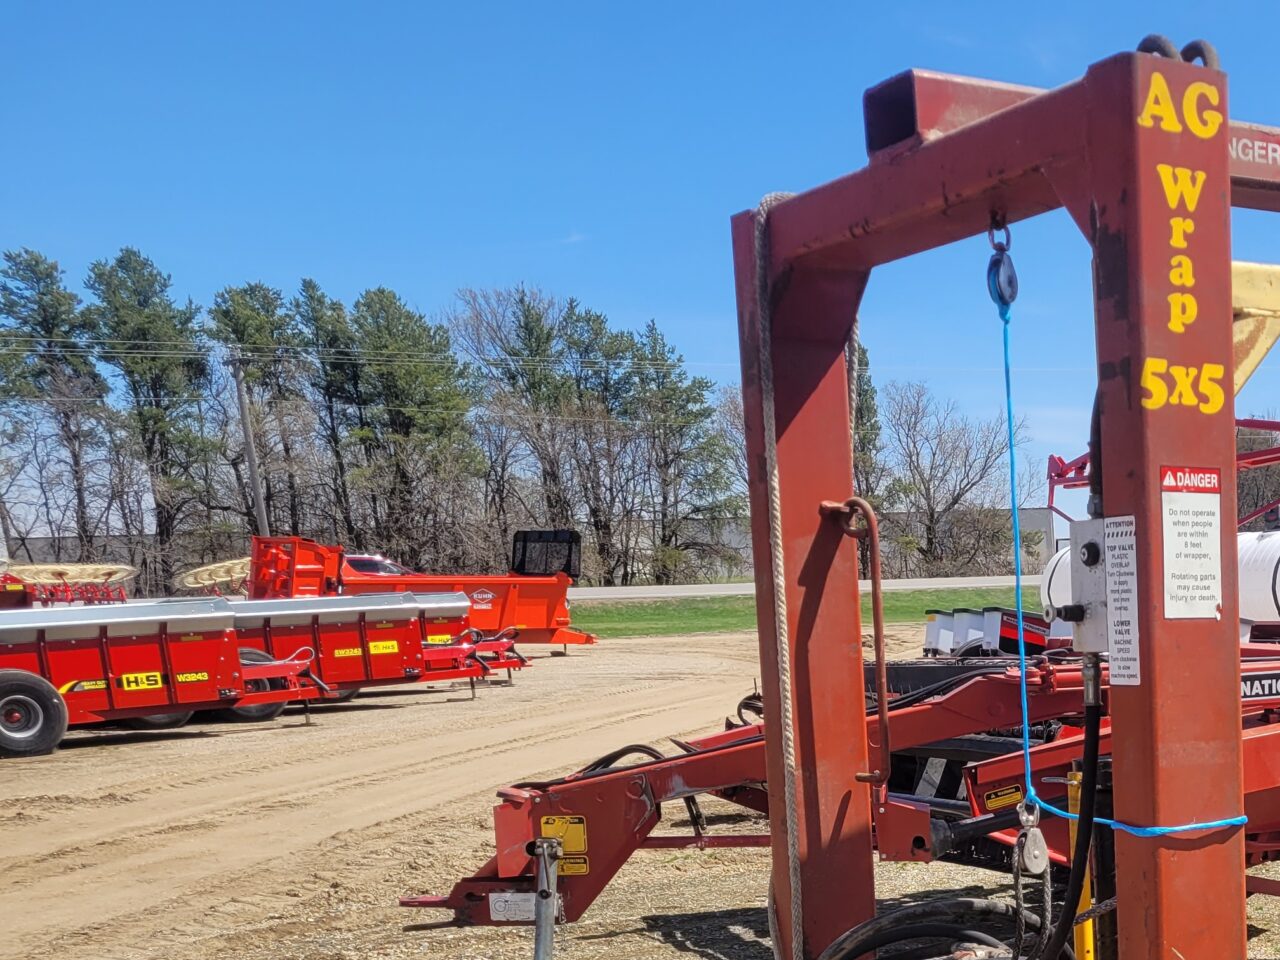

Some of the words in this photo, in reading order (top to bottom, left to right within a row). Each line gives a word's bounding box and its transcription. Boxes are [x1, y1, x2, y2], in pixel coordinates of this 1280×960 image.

[1137, 72, 1223, 139] AG
[1176, 471, 1218, 488] DANGER
[1168, 508, 1178, 516] Do
[1180, 509, 1190, 517] not
[1191, 510, 1216, 518] operate
[1106, 520, 1134, 528] ATTENTION
[1191, 520, 1213, 529] people
[1189, 530, 1209, 538] within
[1190, 541, 1202, 549] feet
[1171, 573, 1199, 581] Rotating
[1200, 573, 1216, 581] parts
[1169, 594, 1188, 603] injury
[126, 674, 159, 688] H&S
[176, 672, 209, 682] W3243
